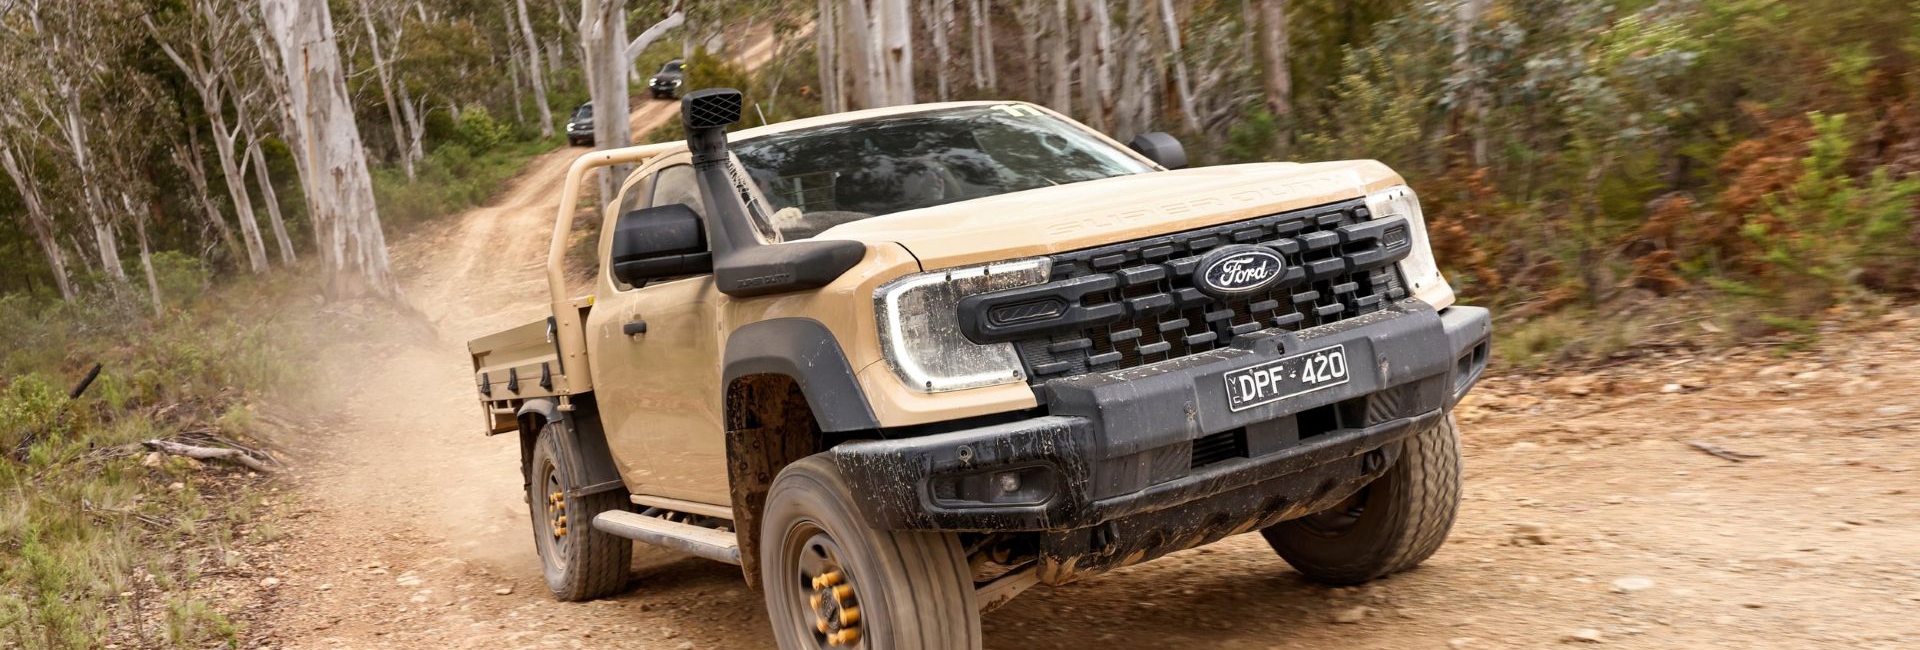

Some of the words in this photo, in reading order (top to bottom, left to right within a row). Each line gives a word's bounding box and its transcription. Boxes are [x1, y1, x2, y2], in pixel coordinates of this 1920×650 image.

[1220, 257, 1269, 286] Ford
[1229, 377, 1241, 404] VIC
[1238, 366, 1284, 402] DPF
[1302, 351, 1345, 384] 420
